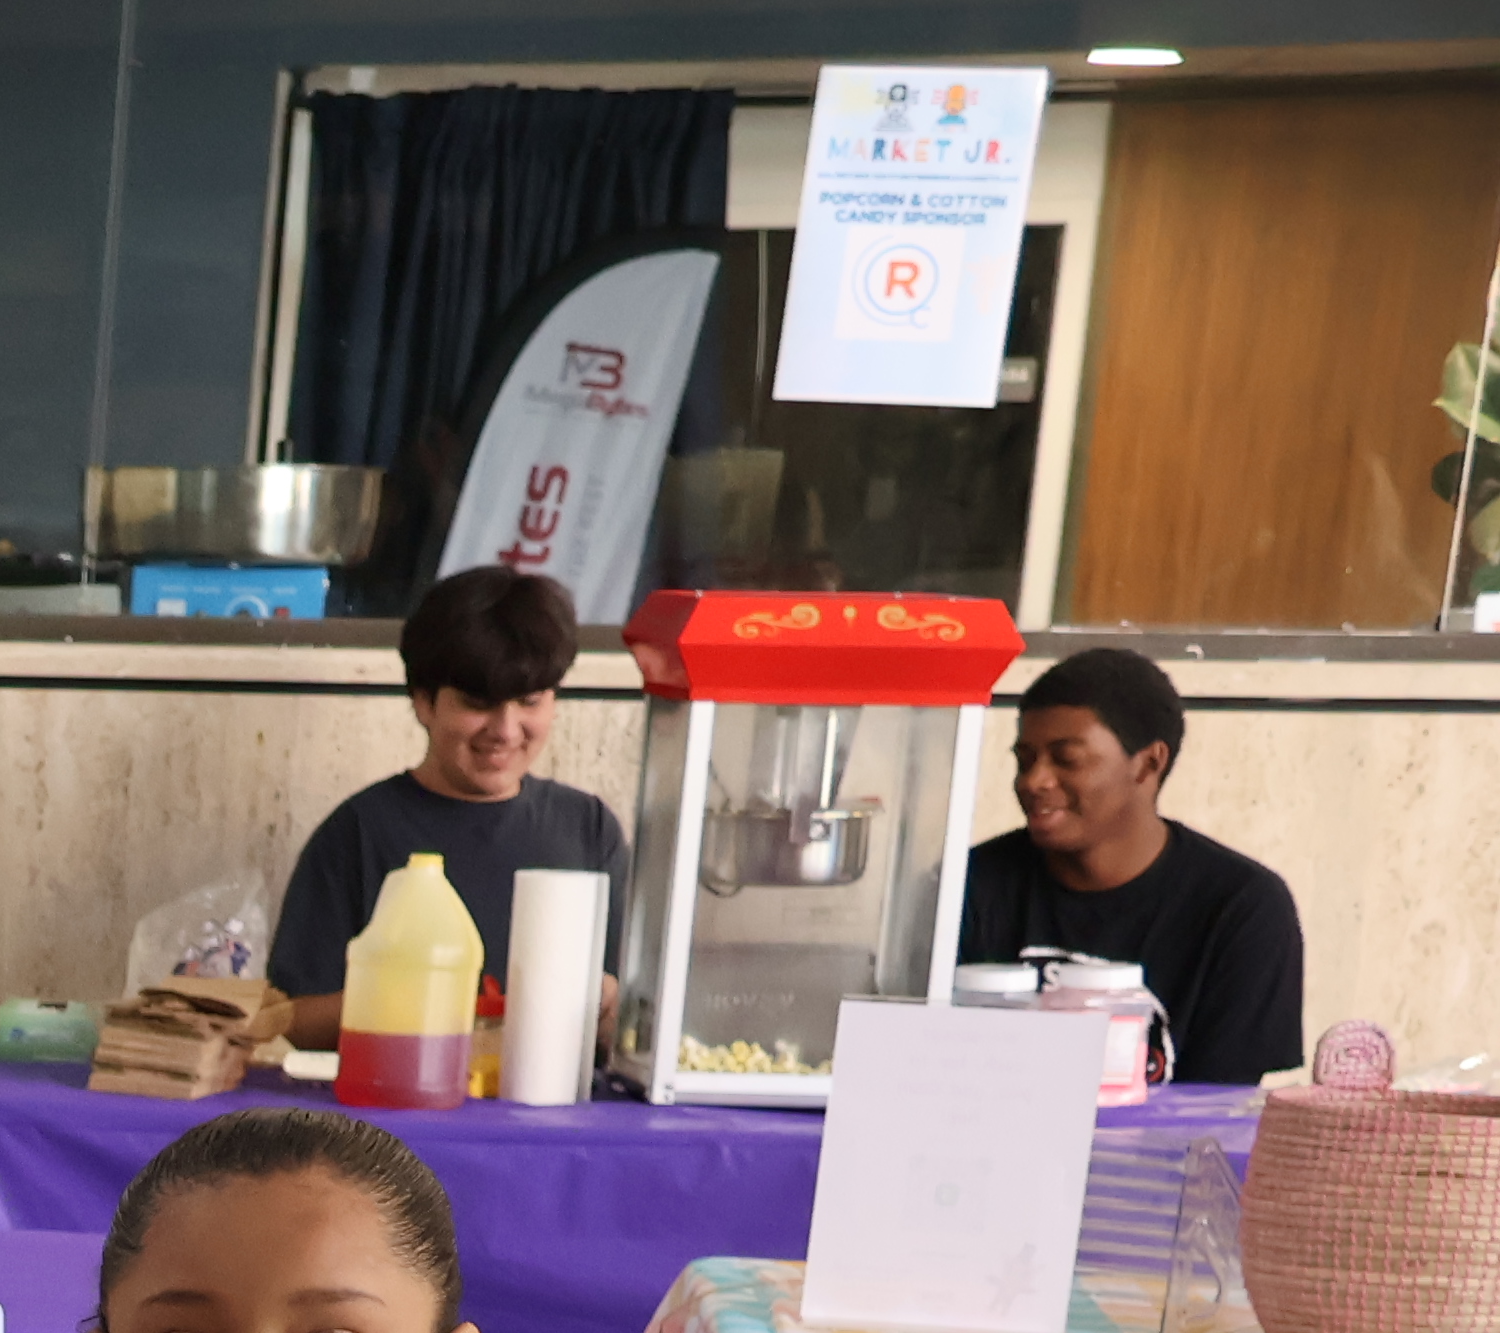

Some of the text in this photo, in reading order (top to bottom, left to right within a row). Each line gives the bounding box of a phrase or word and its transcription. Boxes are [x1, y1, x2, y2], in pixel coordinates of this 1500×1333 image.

[827, 136, 1013, 164] MARKET JR.
[819, 191, 1008, 208] POPCORN & COTTON
[835, 209, 986, 225] CANDY SPONSOR
